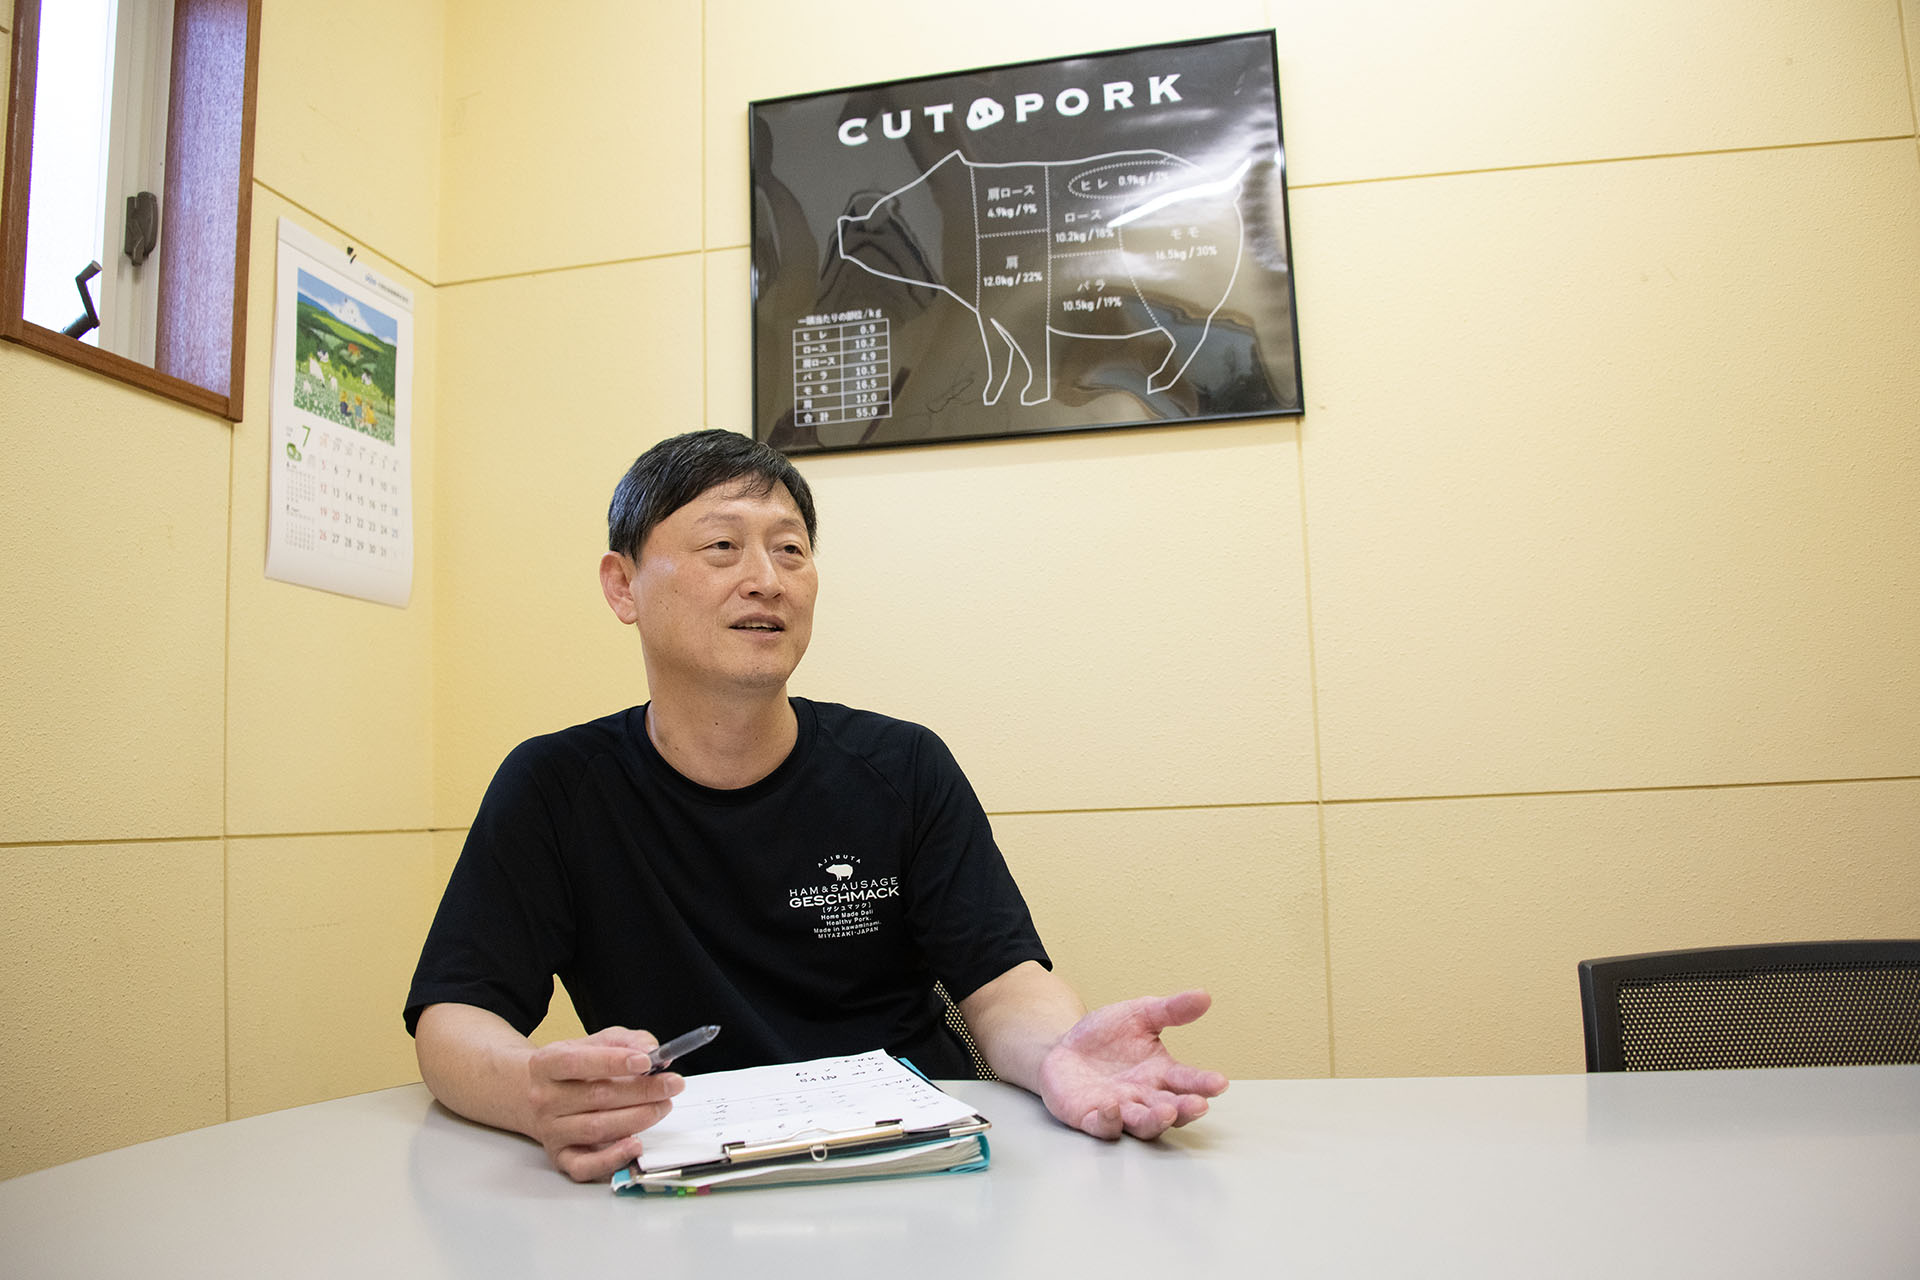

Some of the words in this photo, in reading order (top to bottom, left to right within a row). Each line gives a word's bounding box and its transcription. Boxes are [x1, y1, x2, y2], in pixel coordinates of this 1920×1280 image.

[838, 103, 953, 146] CUT
[1014, 73, 1183, 123] PORK
[1080, 178, 1108, 192] ヒレ
[987, 184, 1035, 201] 肩ロース
[1064, 209, 1102, 223] ロース
[1170, 226, 1200, 240] モモ
[1005, 255, 1019, 269] 肩
[1077, 279, 1106, 292] バラ
[803, 344, 828, 354] ロース
[855, 338, 876, 349] 10.2
[861, 351, 877, 361] 4.9
[855, 365, 877, 376] 10.5
[856, 379, 877, 390] 16.5
[856, 392, 878, 404] 12.0
[856, 406, 878, 418] 55.0
[302, 424, 311, 447] 7
[818, 854, 861, 868] AJIBUTA
[789, 886, 900, 908] GESCHMACK
[826, 918, 853, 926] Healthy
